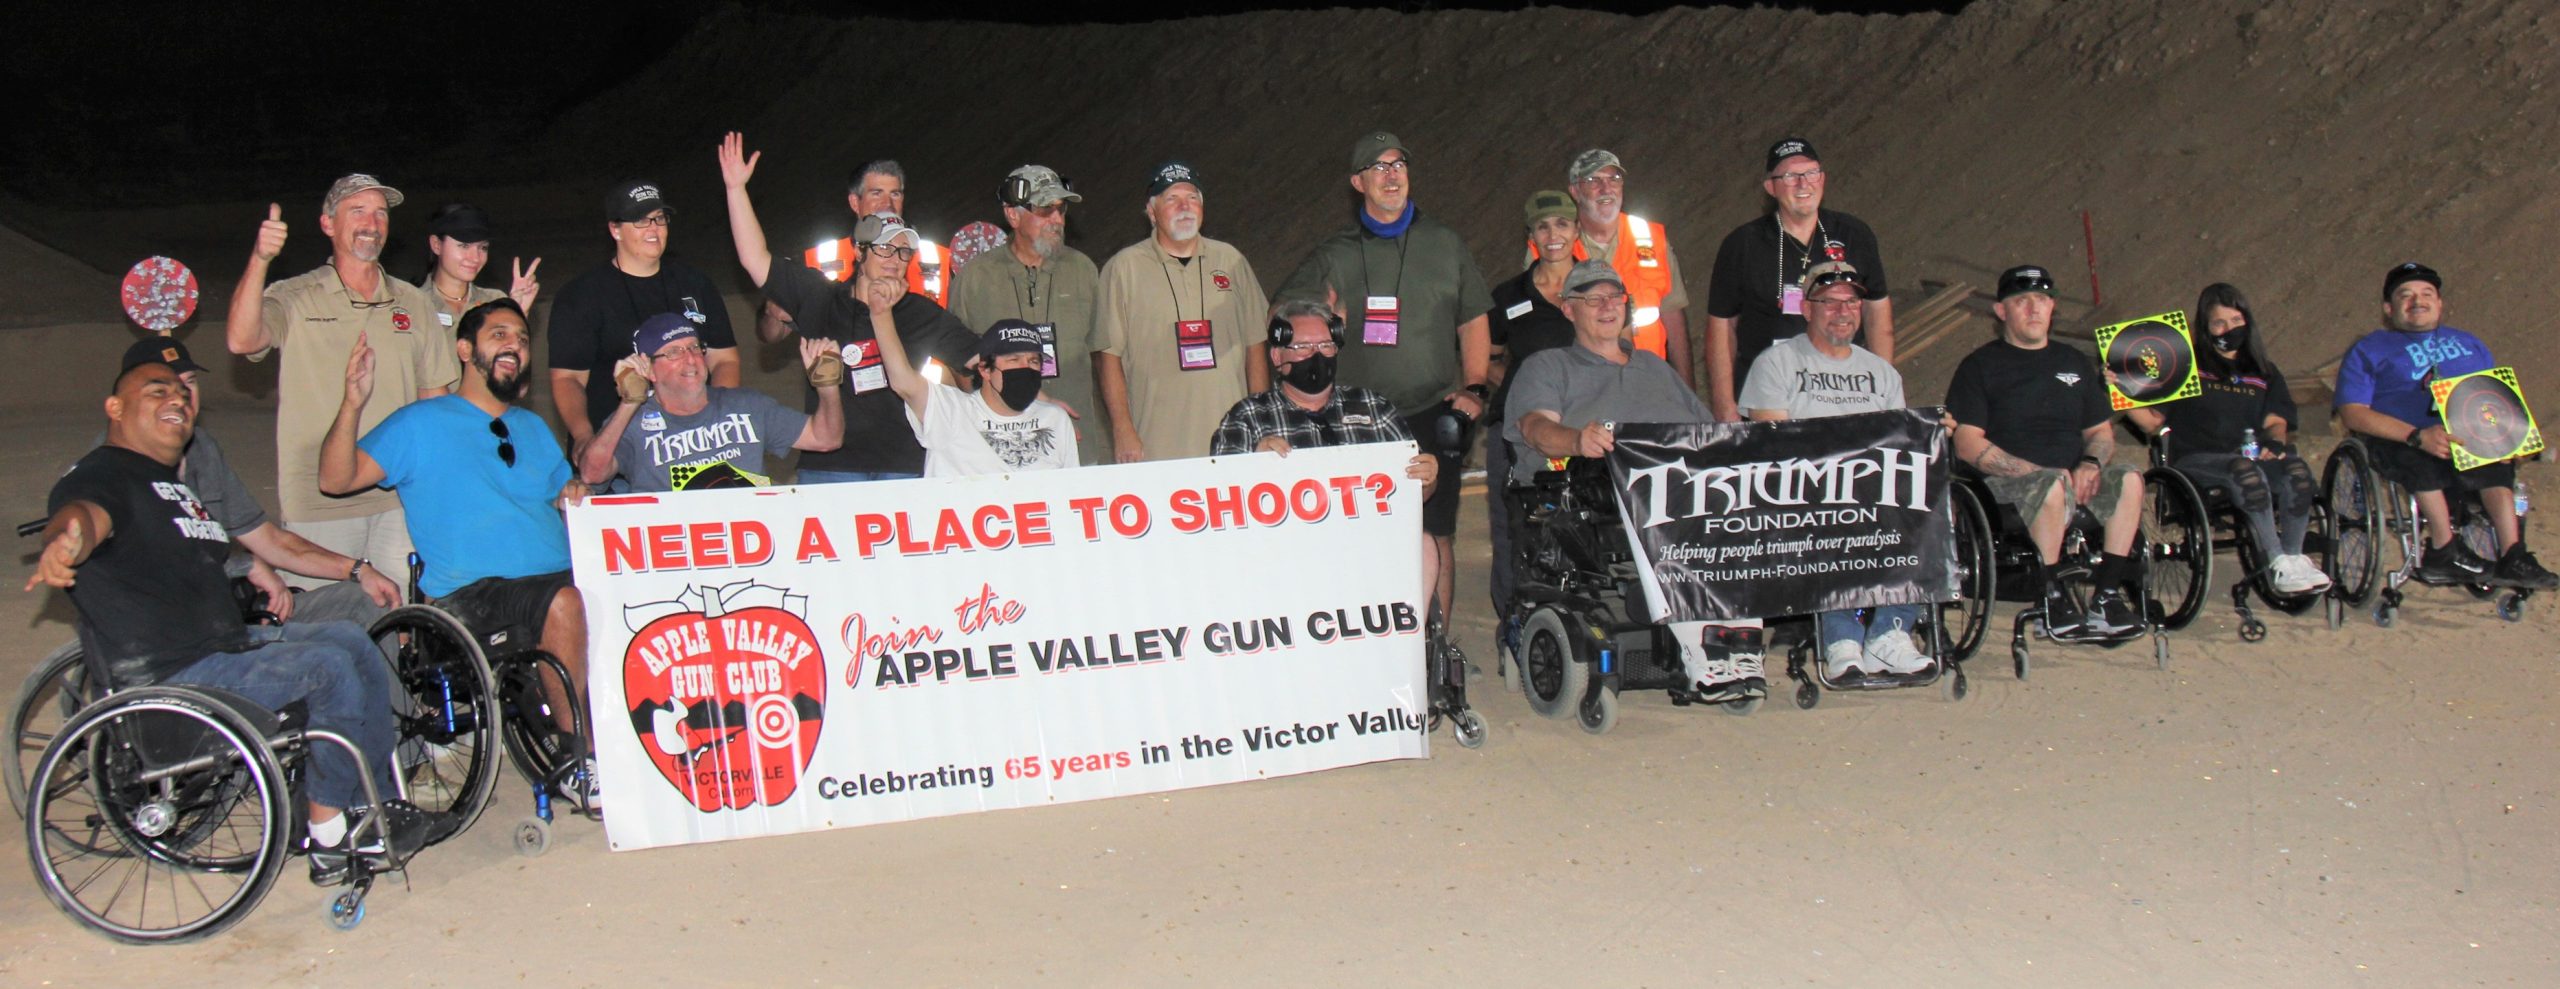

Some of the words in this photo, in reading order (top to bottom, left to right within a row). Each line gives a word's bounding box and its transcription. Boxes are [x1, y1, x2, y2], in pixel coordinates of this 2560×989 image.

[644, 413, 761, 467] TRIUMPH
[1626, 446, 1932, 529] TRIUMPH
[1704, 506, 1878, 535] FOUNDATION
[601, 519, 776, 576] NEED
[796, 516, 841, 565] A
[854, 500, 1055, 561] PLACE
[1069, 493, 1153, 543] TO
[1168, 472, 1398, 535] SHOOT?
[1659, 542, 1716, 565] Helping
[1718, 538, 1764, 564] people
[1766, 533, 1814, 557] triumph
[1815, 535, 1843, 550] over
[1846, 528, 1902, 551] paralysis
[638, 620, 712, 678] APPLE
[720, 618, 815, 672] VALLEY
[840, 611, 944, 689] Join
[954, 581, 1027, 636] the
[875, 642, 1020, 691] APPLE
[1028, 625, 1191, 676] VALLEY
[1203, 615, 1297, 657] GUN
[1306, 601, 1421, 645] CLUB
[671, 664, 716, 699] GUN
[725, 659, 783, 696] CLUB
[817, 763, 995, 801] Celebrating
[1004, 755, 1043, 780] 65
[1050, 750, 1132, 781] years
[1140, 740, 1171, 765] in
[1181, 734, 1234, 760] the
[1242, 721, 1340, 752] Victor
[1348, 707, 1427, 737] Valley
